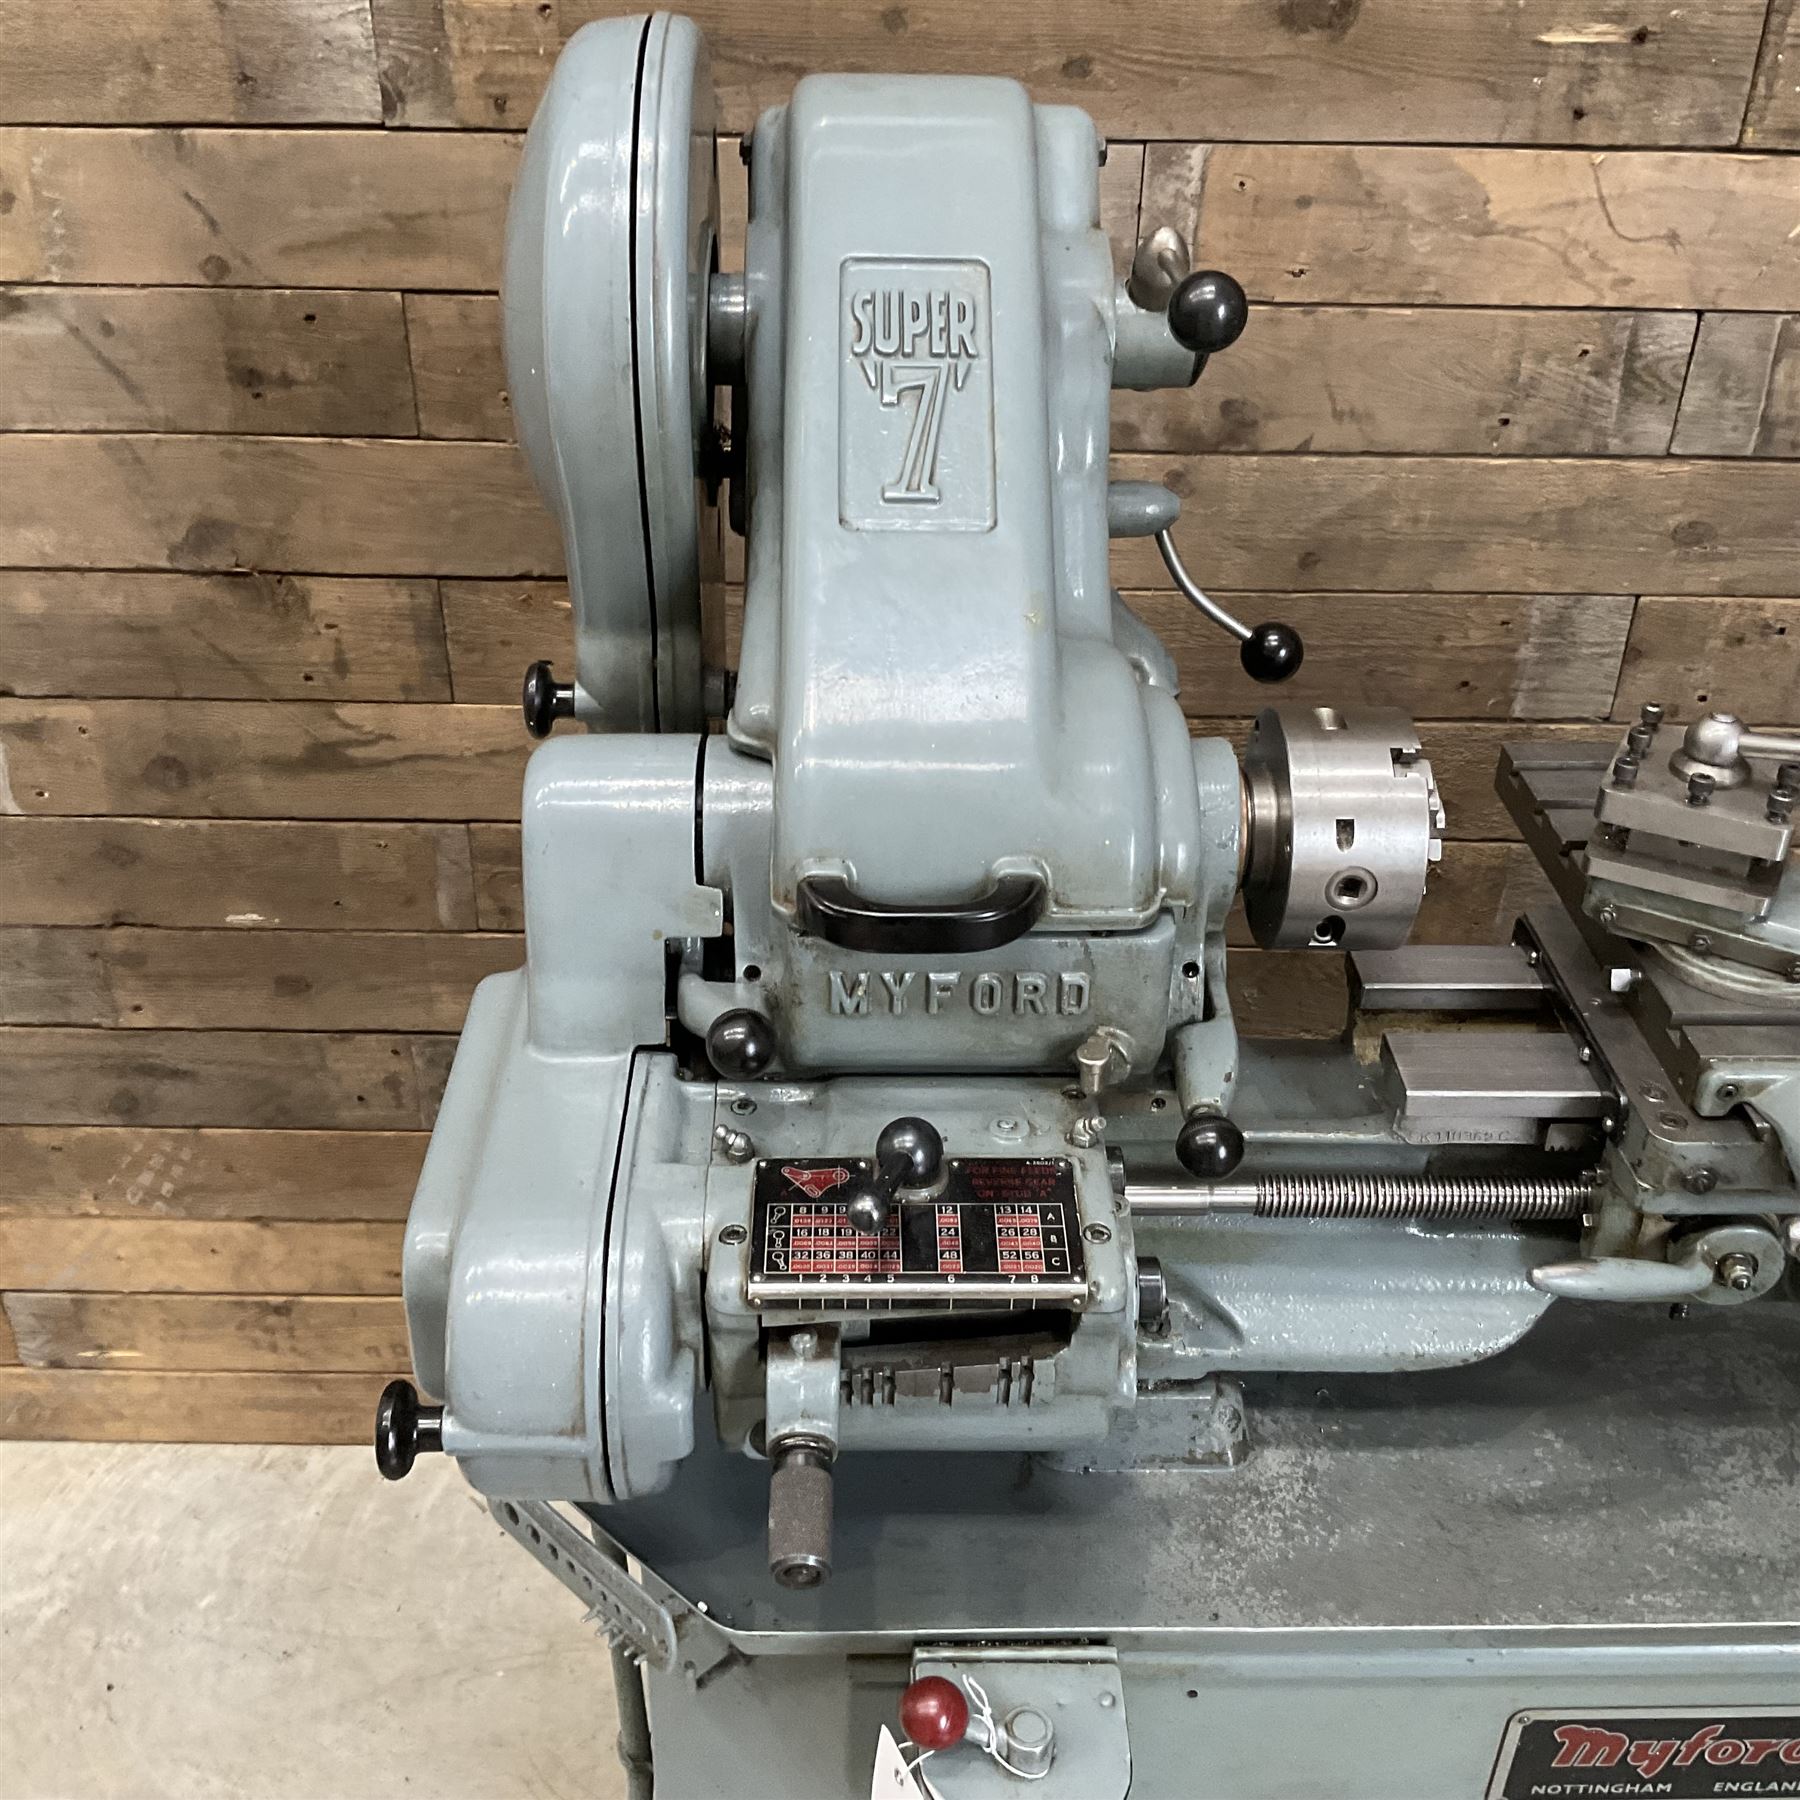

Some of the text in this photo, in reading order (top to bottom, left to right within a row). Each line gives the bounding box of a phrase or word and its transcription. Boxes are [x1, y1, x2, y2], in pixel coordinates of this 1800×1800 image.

[851, 290, 978, 358] SUPER
[828, 970, 1091, 1016] MYFORD
[800, 1206, 807, 1214] 8
[821, 1206, 829, 1214] 9
[941, 1206, 953, 1214] 12
[1000, 1206, 1012, 1214] 13
[1021, 1206, 1033, 1214] 14
[796, 1228, 808, 1236] 16
[818, 1228, 830, 1236] 18
[841, 1228, 853, 1236] 19
[882, 1228, 896, 1236] 22
[941, 1228, 955, 1236] 24
[1001, 1228, 1016, 1236] 26
[1022, 1228, 1038, 1236] 28
[1050, 1235, 1058, 1243] B
[793, 1251, 1061, 1266] 32 36 38 40 44 48 52 56 C
[798, 1274, 1039, 1284] 1 2 3 4 5 6 7 8
[1531, 1781, 1800, 1795] NOTTINGHAM ENGLAN
